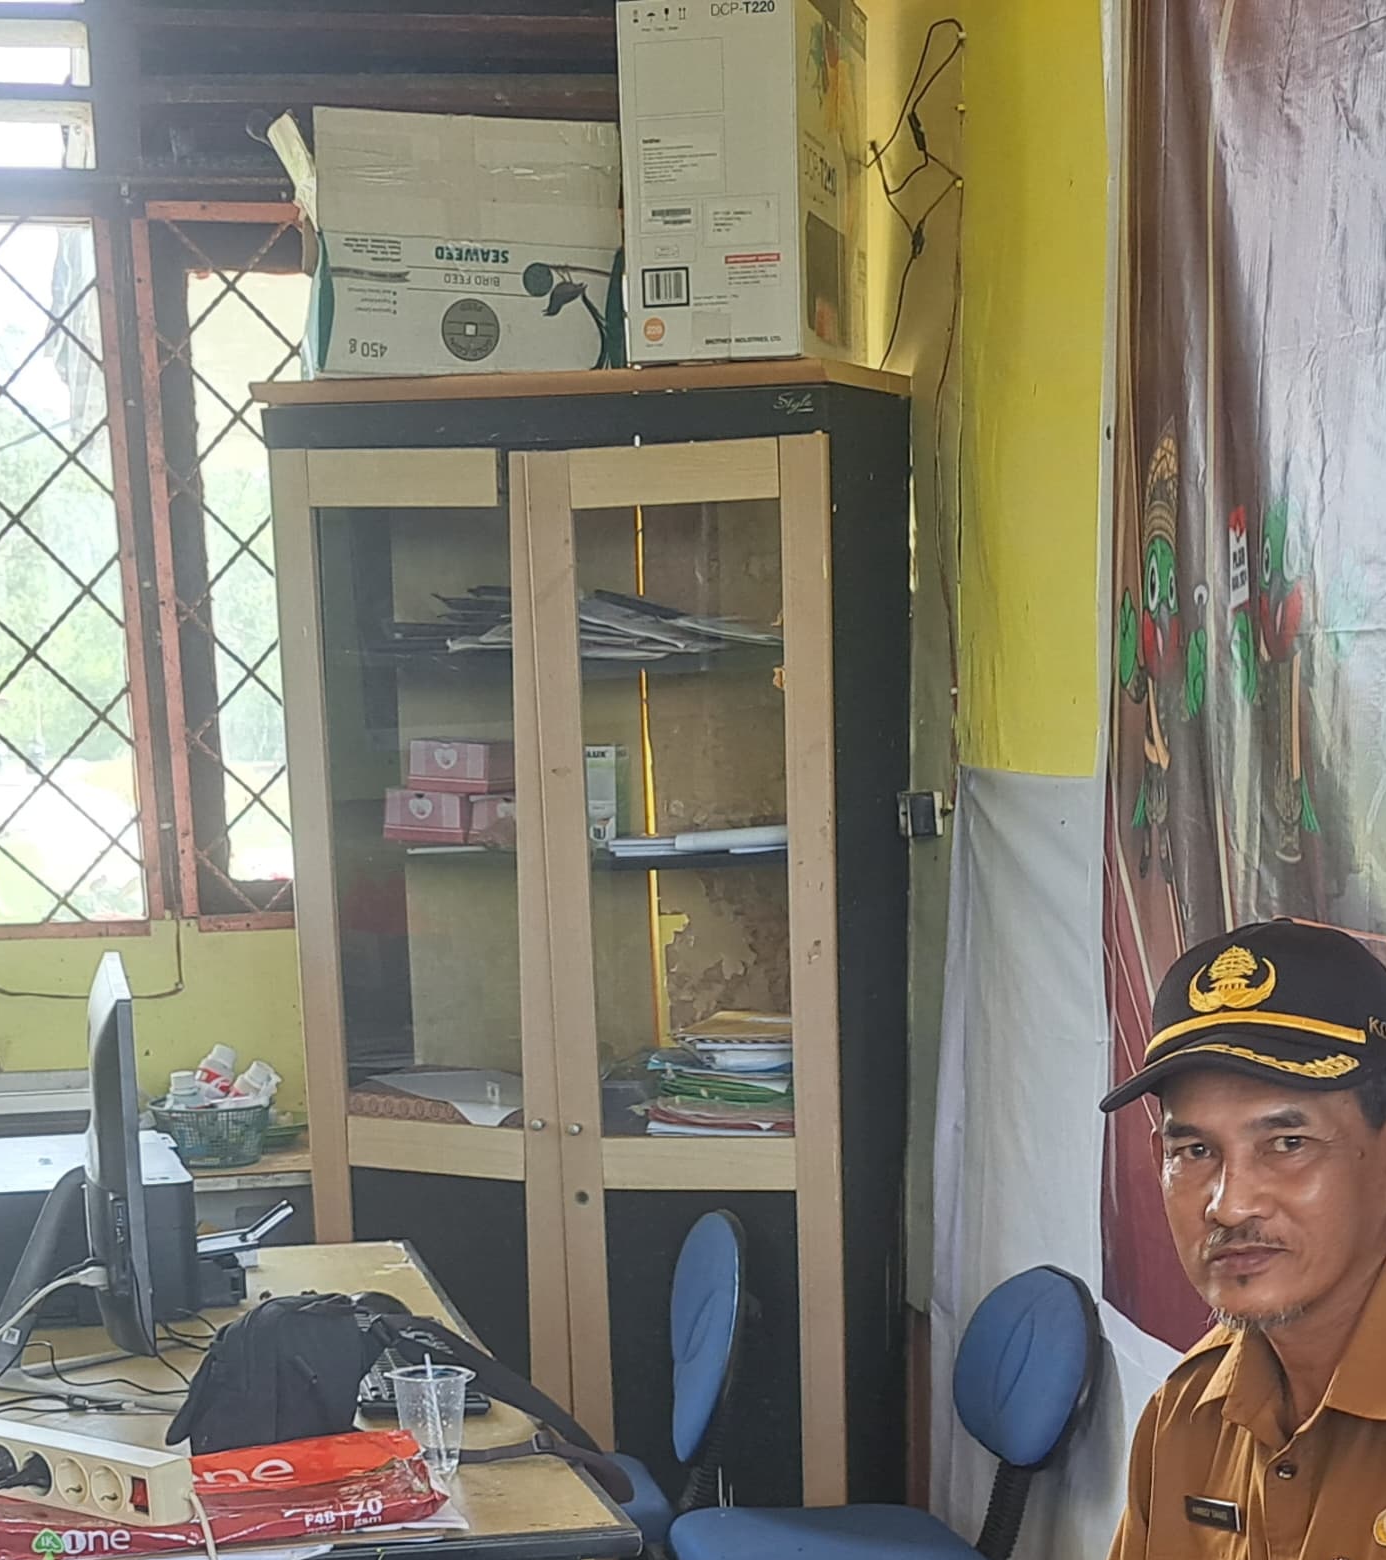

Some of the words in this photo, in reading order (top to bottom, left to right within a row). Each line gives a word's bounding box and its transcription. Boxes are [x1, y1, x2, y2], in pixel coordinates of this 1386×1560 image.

[710, 0, 775, 17] DCP-T220
[435, 246, 510, 264] SEAWEED
[444, 272, 472, 285] FEED
[474, 275, 501, 287] BIRD
[361, 341, 388, 358] 450
[773, 393, 814, 415] Style
[193, 1459, 295, 1483] ne
[353, 1497, 383, 1518] 70
